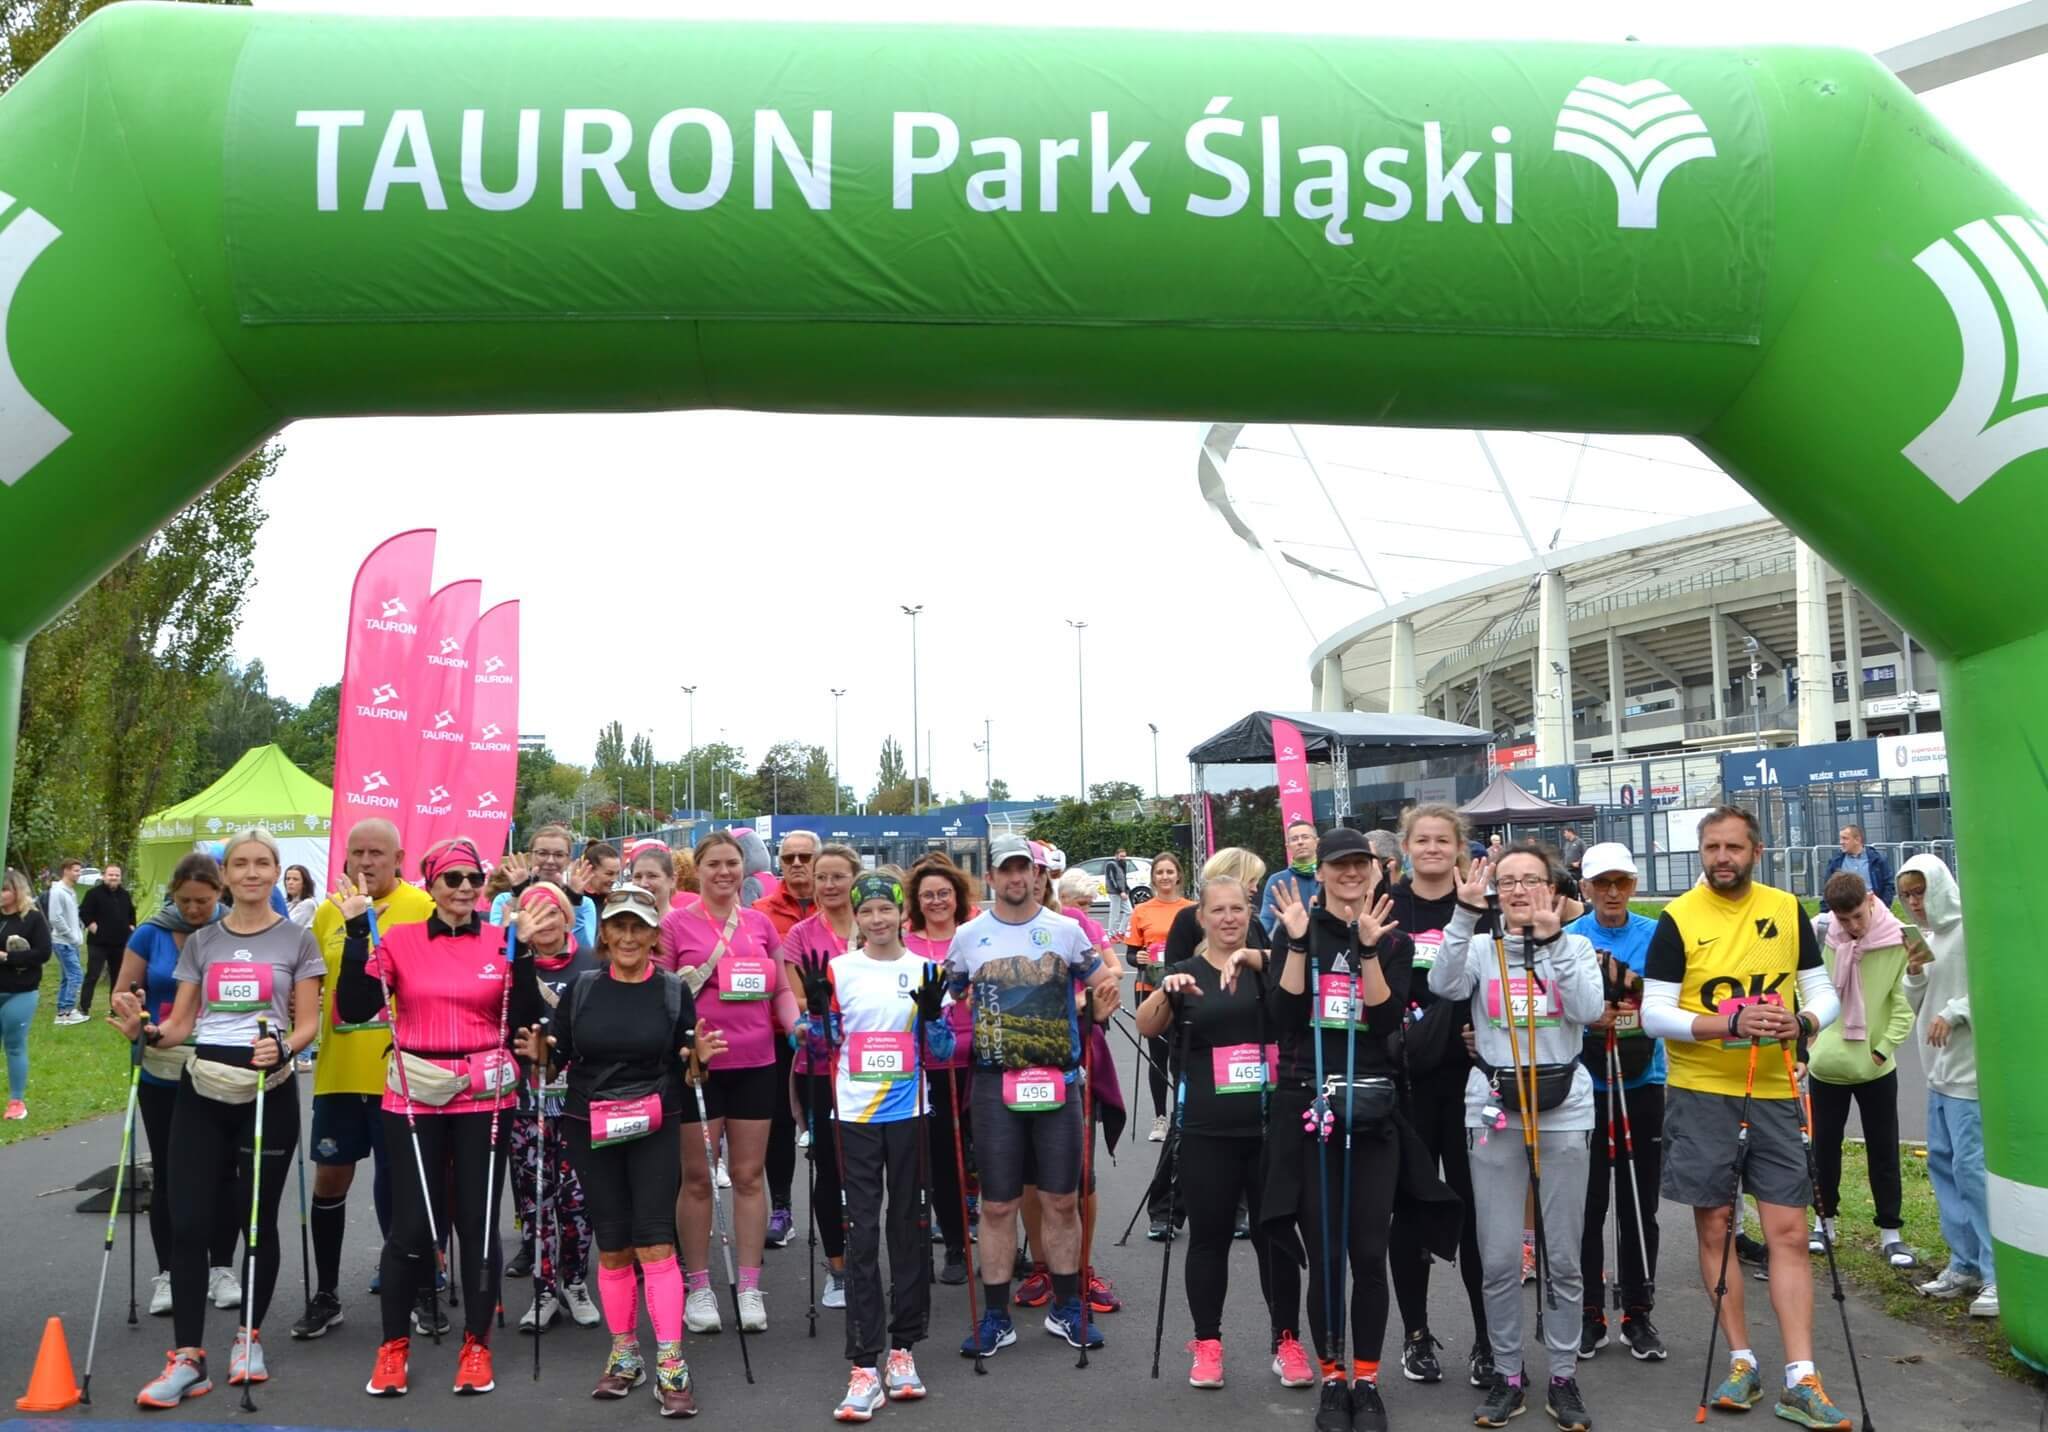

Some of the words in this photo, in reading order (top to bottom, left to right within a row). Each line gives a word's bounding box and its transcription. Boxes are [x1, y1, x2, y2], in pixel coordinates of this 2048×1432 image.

[295, 108, 832, 212] TAURON
[893, 110, 1152, 216] Park
[1186, 95, 1514, 246] Śląski
[366, 618, 418, 635] TAURON
[427, 655, 469, 669] TAURON
[356, 704, 408, 721] TAURON
[421, 729, 464, 743] TAURON
[470, 742, 511, 752] TAURON
[1755, 758, 1778, 785] 1A
[1538, 774, 1557, 799] 1A
[346, 792, 399, 809] TAURON
[467, 809, 507, 820] TAURON
[736, 977, 760, 989] 486
[224, 985, 251, 998] 468
[867, 1055, 895, 1068] 469
[1235, 1066, 1262, 1079] 465
[1022, 1086, 1048, 1099] 496
[613, 1121, 642, 1134] 459
